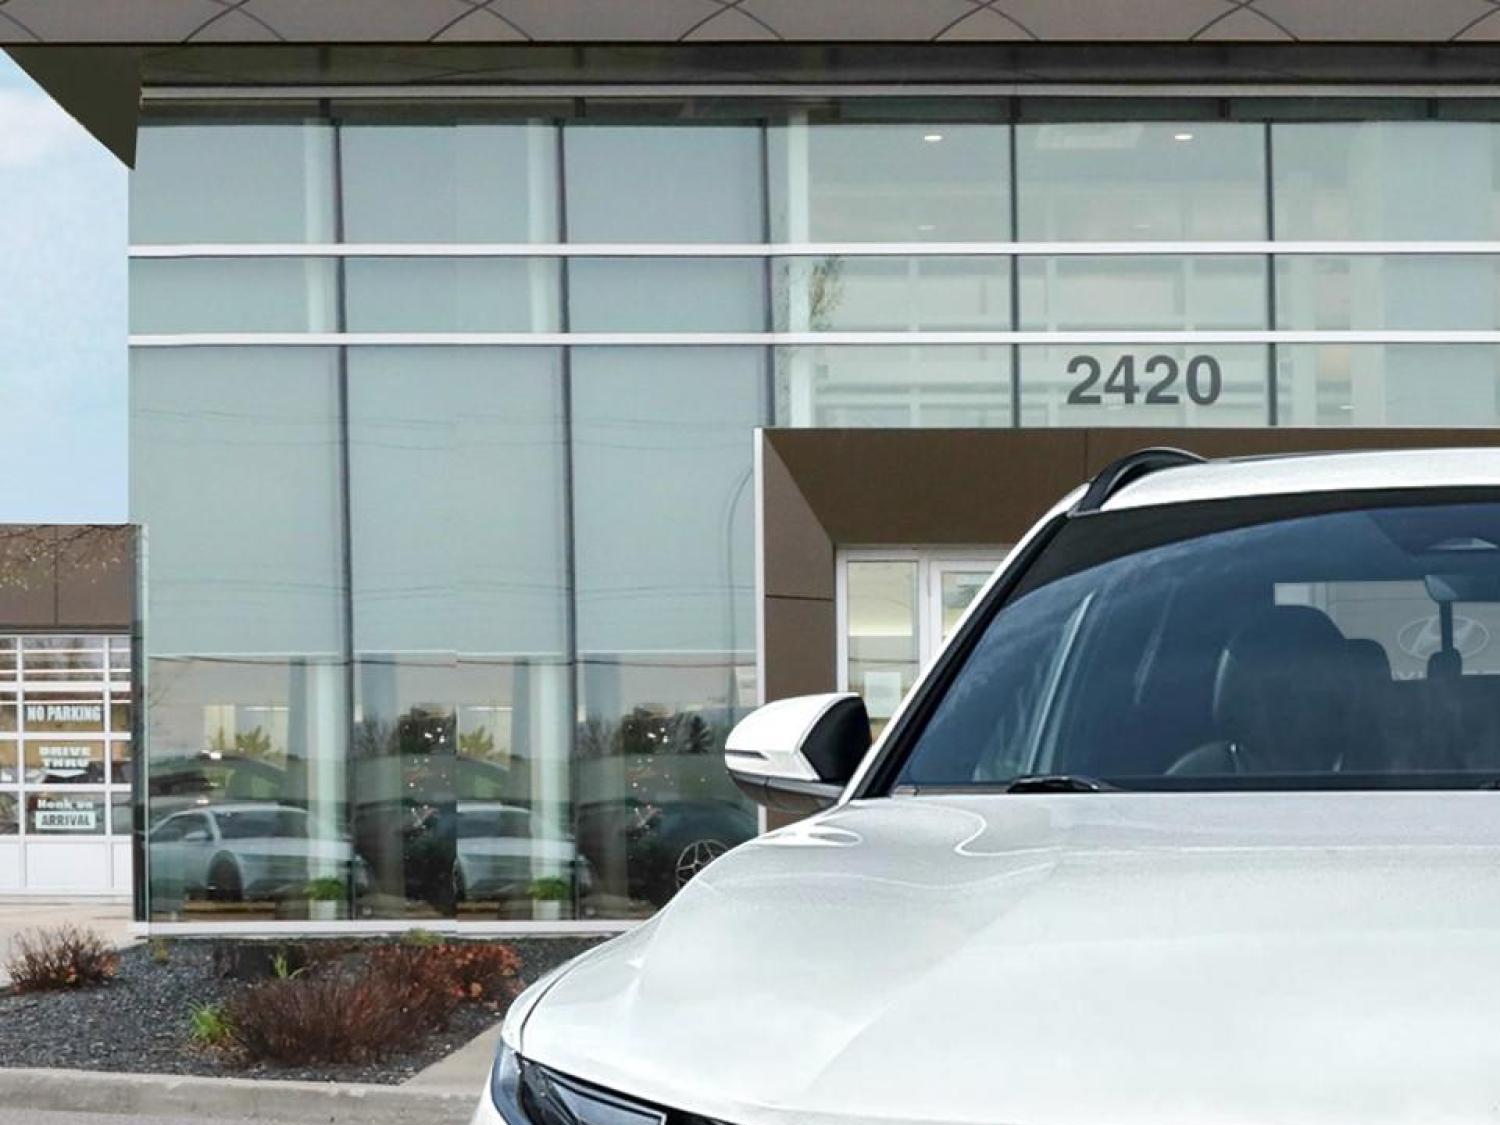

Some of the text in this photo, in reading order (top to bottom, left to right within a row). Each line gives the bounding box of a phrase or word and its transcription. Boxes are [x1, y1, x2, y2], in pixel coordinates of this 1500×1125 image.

[1066, 354, 1222, 406] 2420
[27, 705, 101, 721] NO PARKING
[41, 813, 91, 826] ARRIVAL
